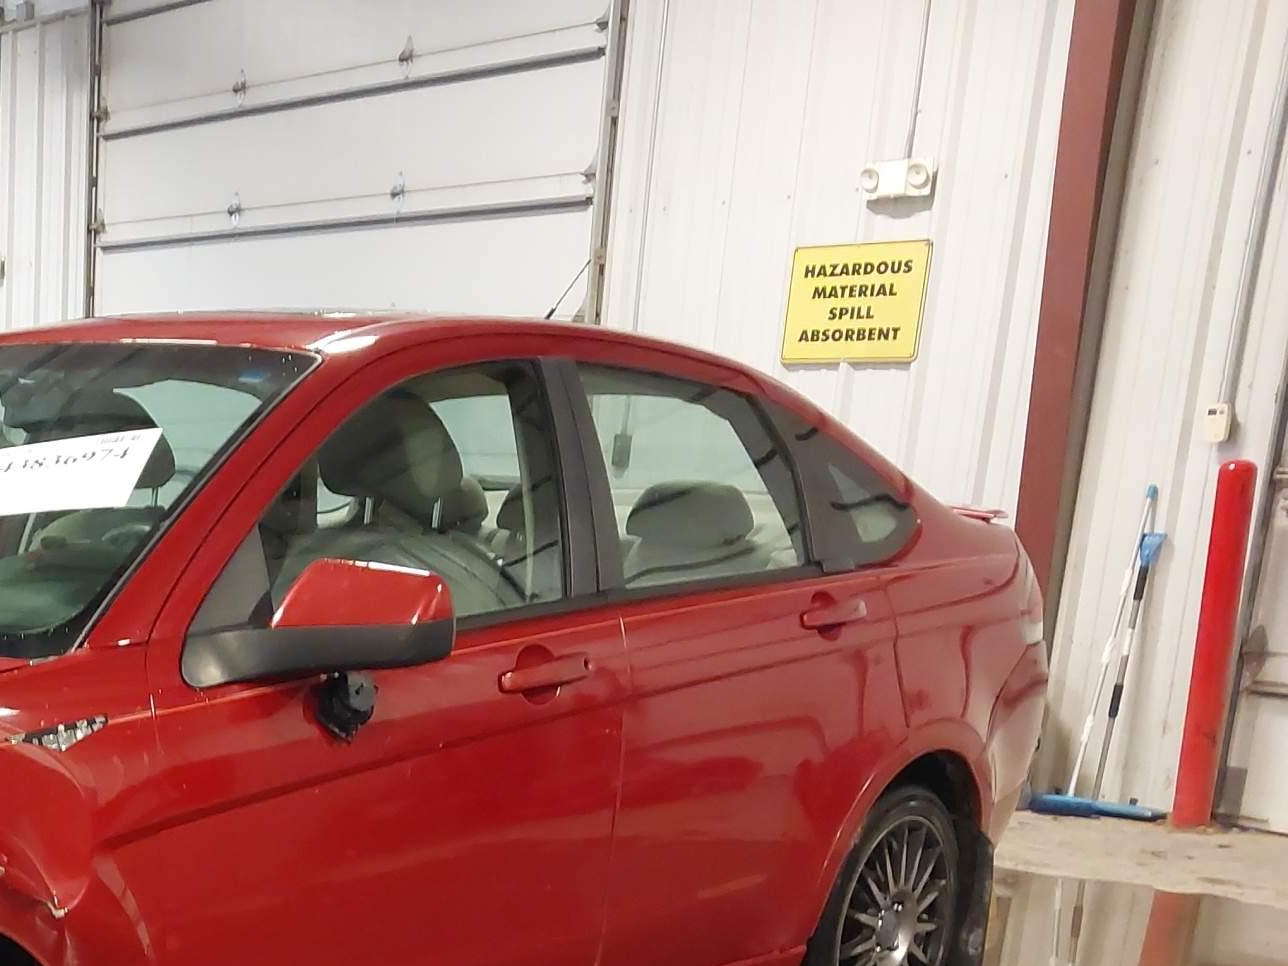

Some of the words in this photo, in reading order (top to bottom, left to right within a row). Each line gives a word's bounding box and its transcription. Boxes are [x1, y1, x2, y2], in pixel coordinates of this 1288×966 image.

[804, 259, 914, 279] HAZARDOUS
[811, 283, 898, 300] MATERIAL
[827, 306, 874, 321] SPILL
[798, 327, 901, 343] ABSORBENT
